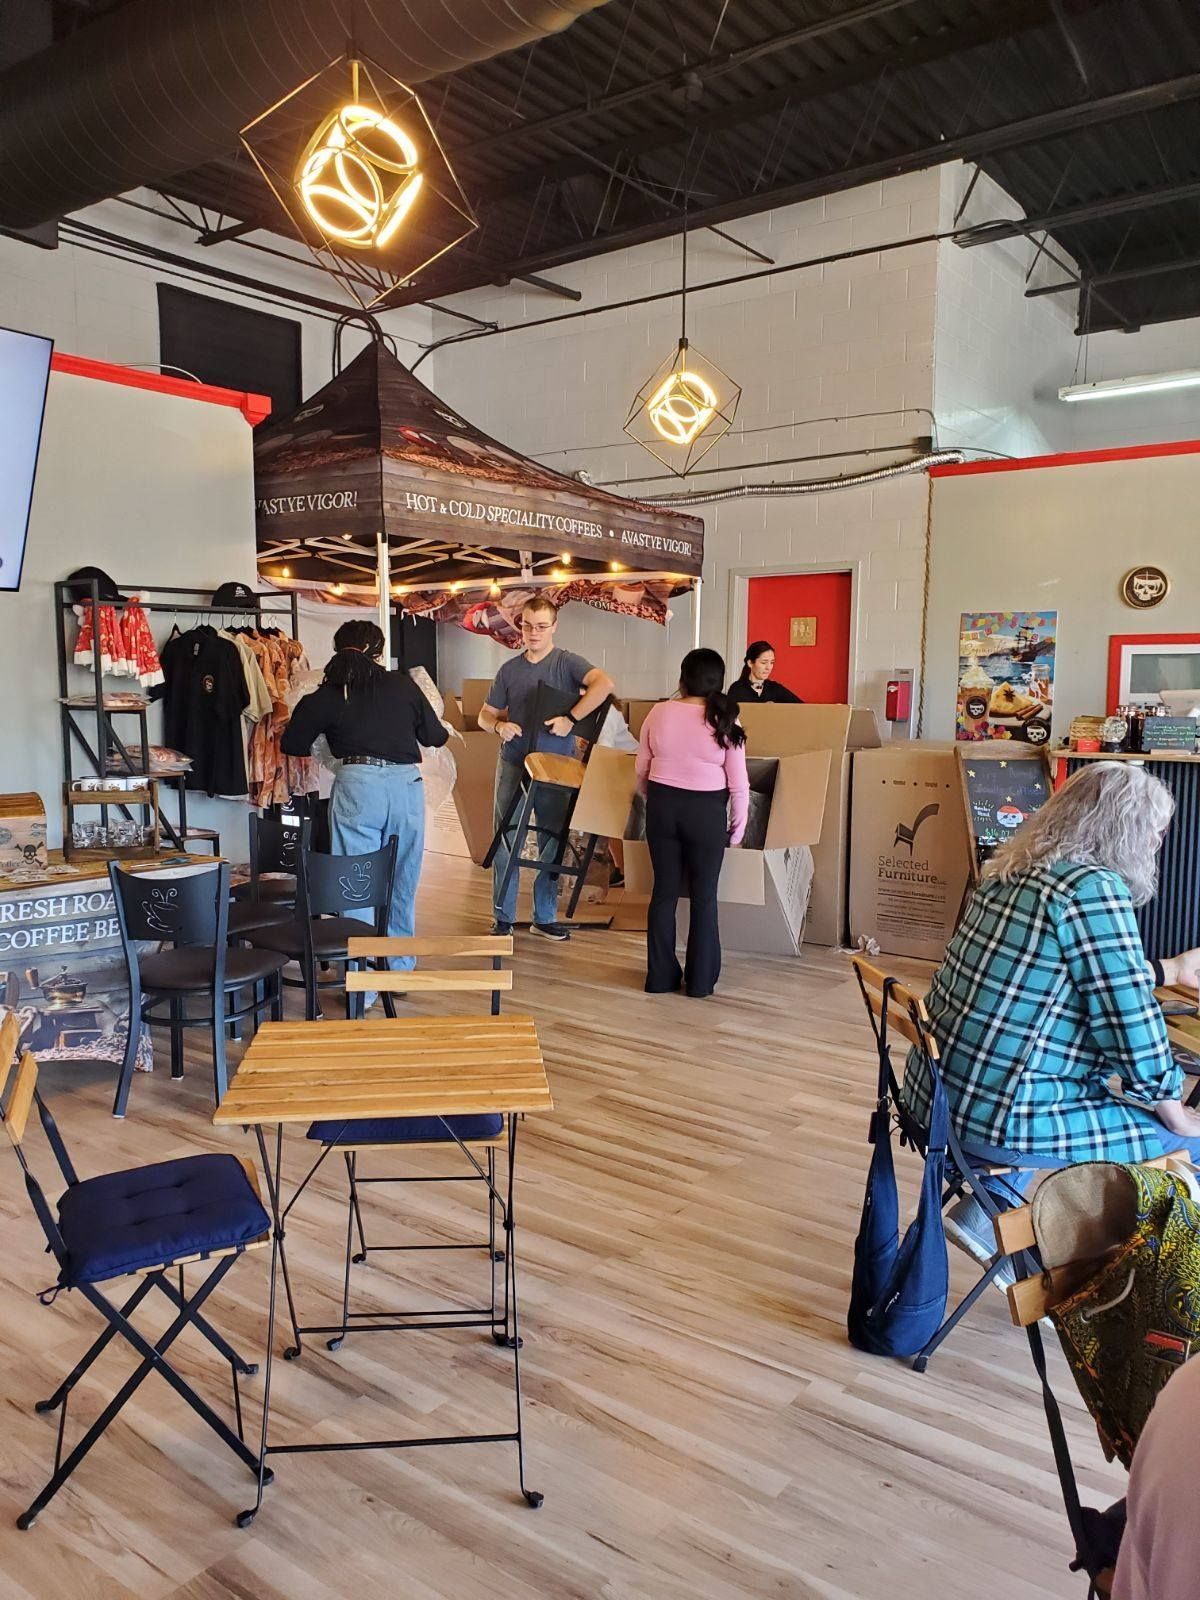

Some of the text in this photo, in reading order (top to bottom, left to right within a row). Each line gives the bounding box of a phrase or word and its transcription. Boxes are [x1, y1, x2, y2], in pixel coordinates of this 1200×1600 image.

[307, 490, 358, 511] VIGOR!
[405, 493, 603, 539] HOT & COLD SPECIALITY COFFEES
[662, 538, 692, 556] VIGOR!
[878, 855, 929, 871] Selected
[878, 867, 938, 884] Furniture
[0, 922, 90, 951] COFFEE
